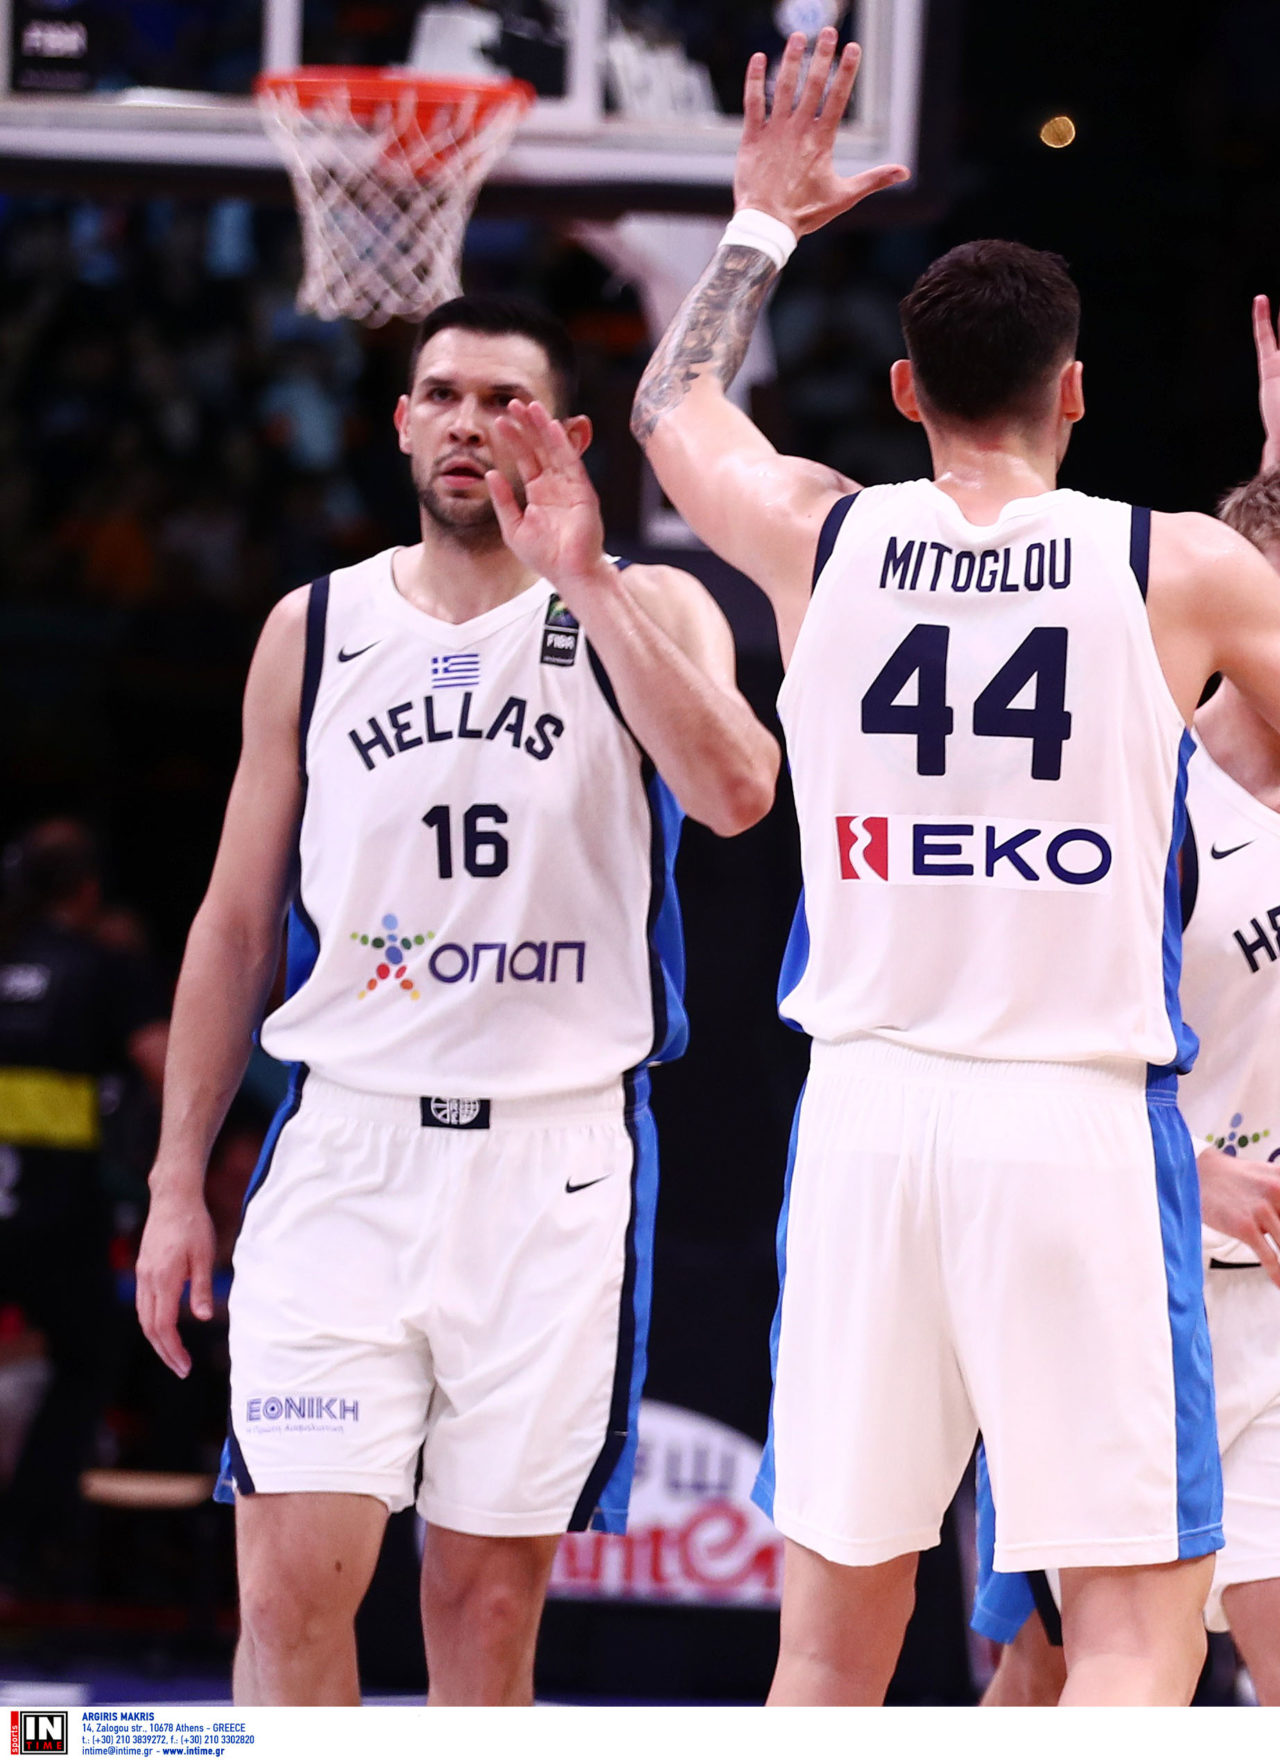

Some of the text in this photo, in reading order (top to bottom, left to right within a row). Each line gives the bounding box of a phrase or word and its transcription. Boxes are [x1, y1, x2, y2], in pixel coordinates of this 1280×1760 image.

[879, 536, 1072, 592] MITOGLOU
[349, 692, 564, 771] HELLAS
[861, 623, 1072, 781] 44
[422, 804, 508, 879] 16
[912, 823, 1112, 885] EKO
